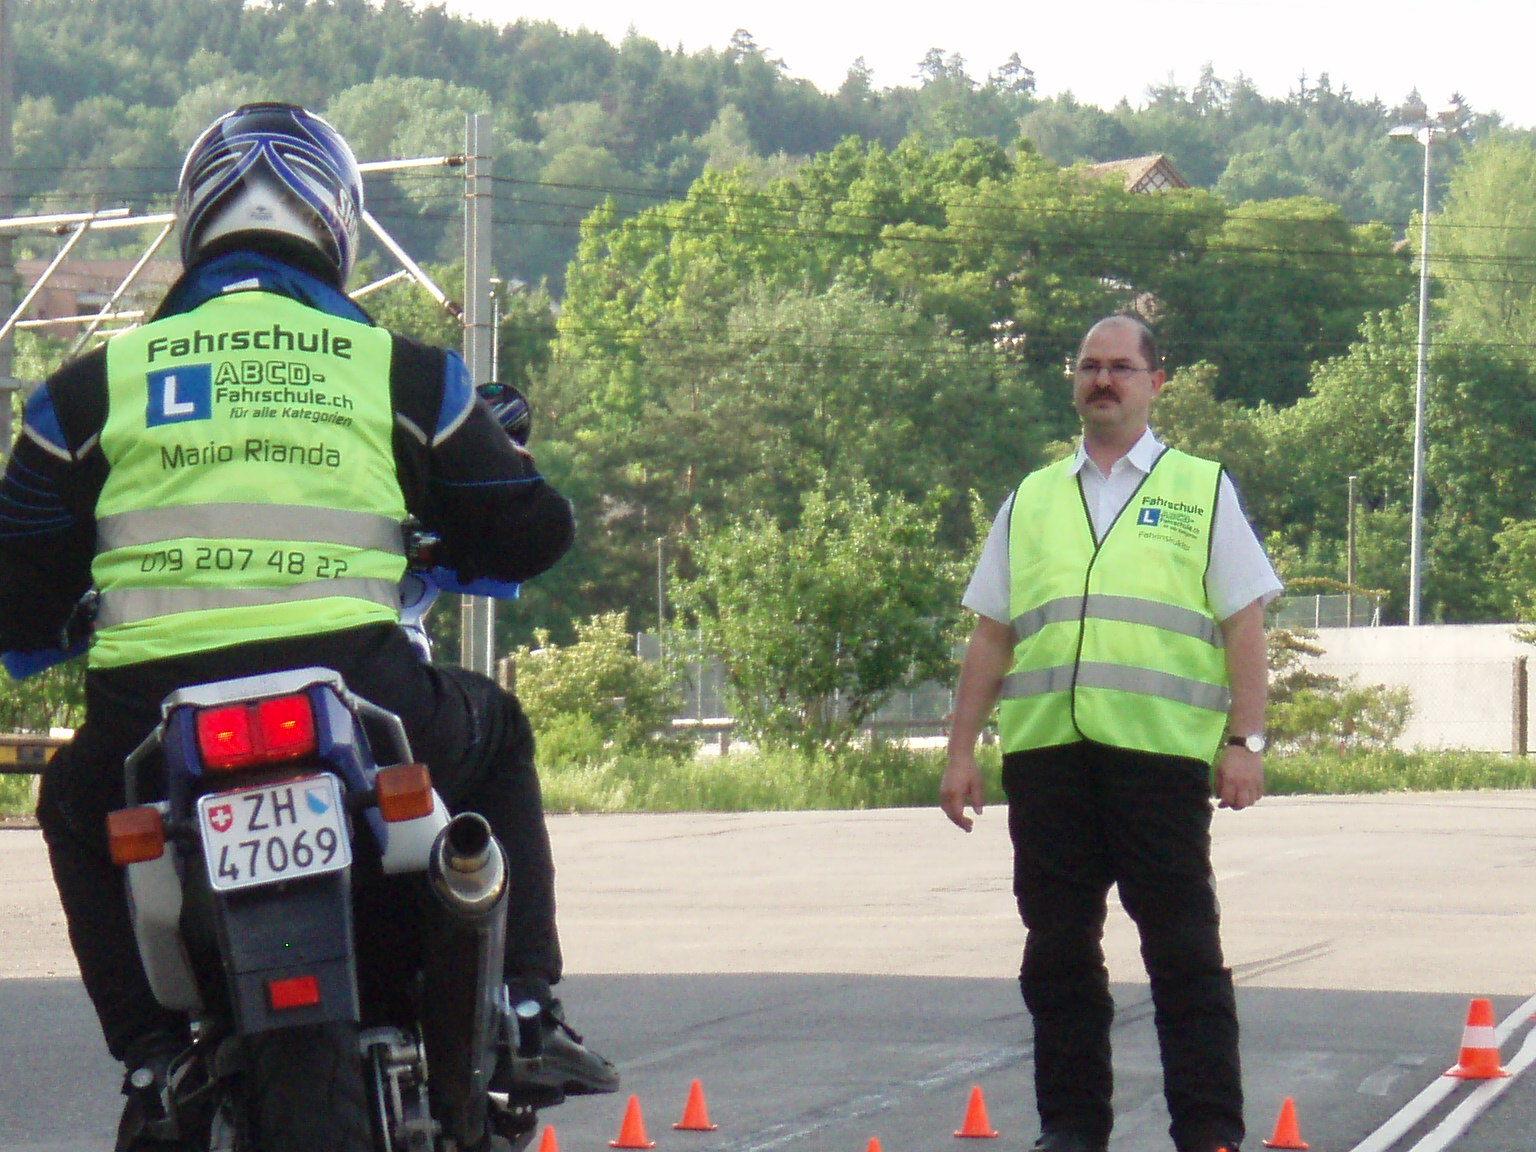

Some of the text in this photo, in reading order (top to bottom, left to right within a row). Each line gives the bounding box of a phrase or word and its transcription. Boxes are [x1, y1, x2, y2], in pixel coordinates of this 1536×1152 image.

[147, 324, 353, 361] Fahrschule
[214, 360, 326, 386] ABCD-
[163, 374, 196, 417] L
[215, 387, 354, 411] Fahrschule.ch
[229, 405, 353, 428] für alle Kategorien
[160, 438, 341, 471] Mario Rianda
[1141, 495, 1205, 517] Fahrschule
[1143, 510, 1155, 524] L
[196, 547, 255, 571] 207
[267, 550, 306, 576] 48
[243, 788, 298, 832] ZH
[218, 826, 338, 881] 47069
